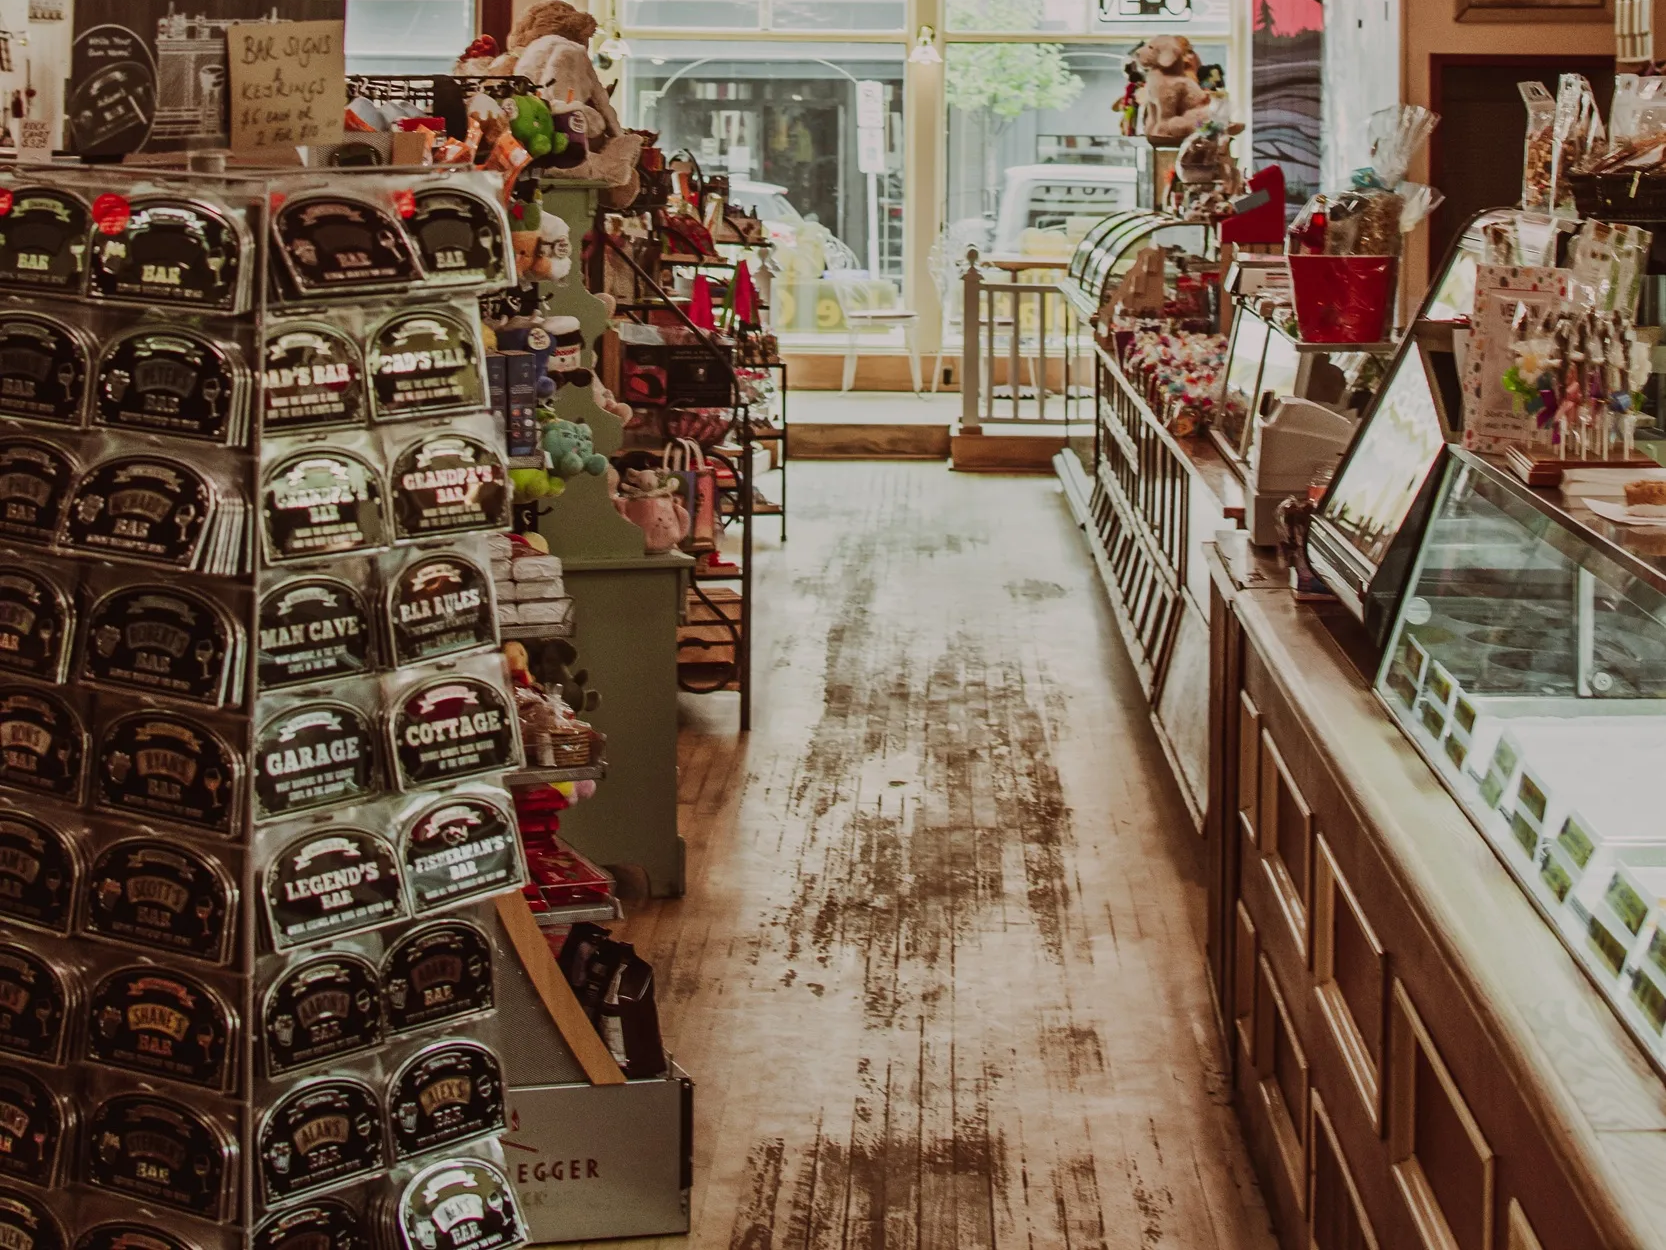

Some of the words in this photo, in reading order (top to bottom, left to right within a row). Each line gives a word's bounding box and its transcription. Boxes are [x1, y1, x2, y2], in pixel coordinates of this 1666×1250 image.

[241, 35, 279, 64] BAR
[283, 34, 332, 68] SIGNS
[312, 363, 351, 385] BAR
[402, 464, 494, 491] GRANDPA'S
[259, 624, 306, 650] MAN
[309, 616, 360, 642] CAVE
[405, 709, 502, 747] COTTAGE
[264, 736, 361, 777] GARAGE
[414, 834, 506, 874] FISHERMAN'S
[449, 860, 479, 881] BAR
[284, 861, 380, 902] LEGEND'S
[321, 889, 354, 910] BAR
